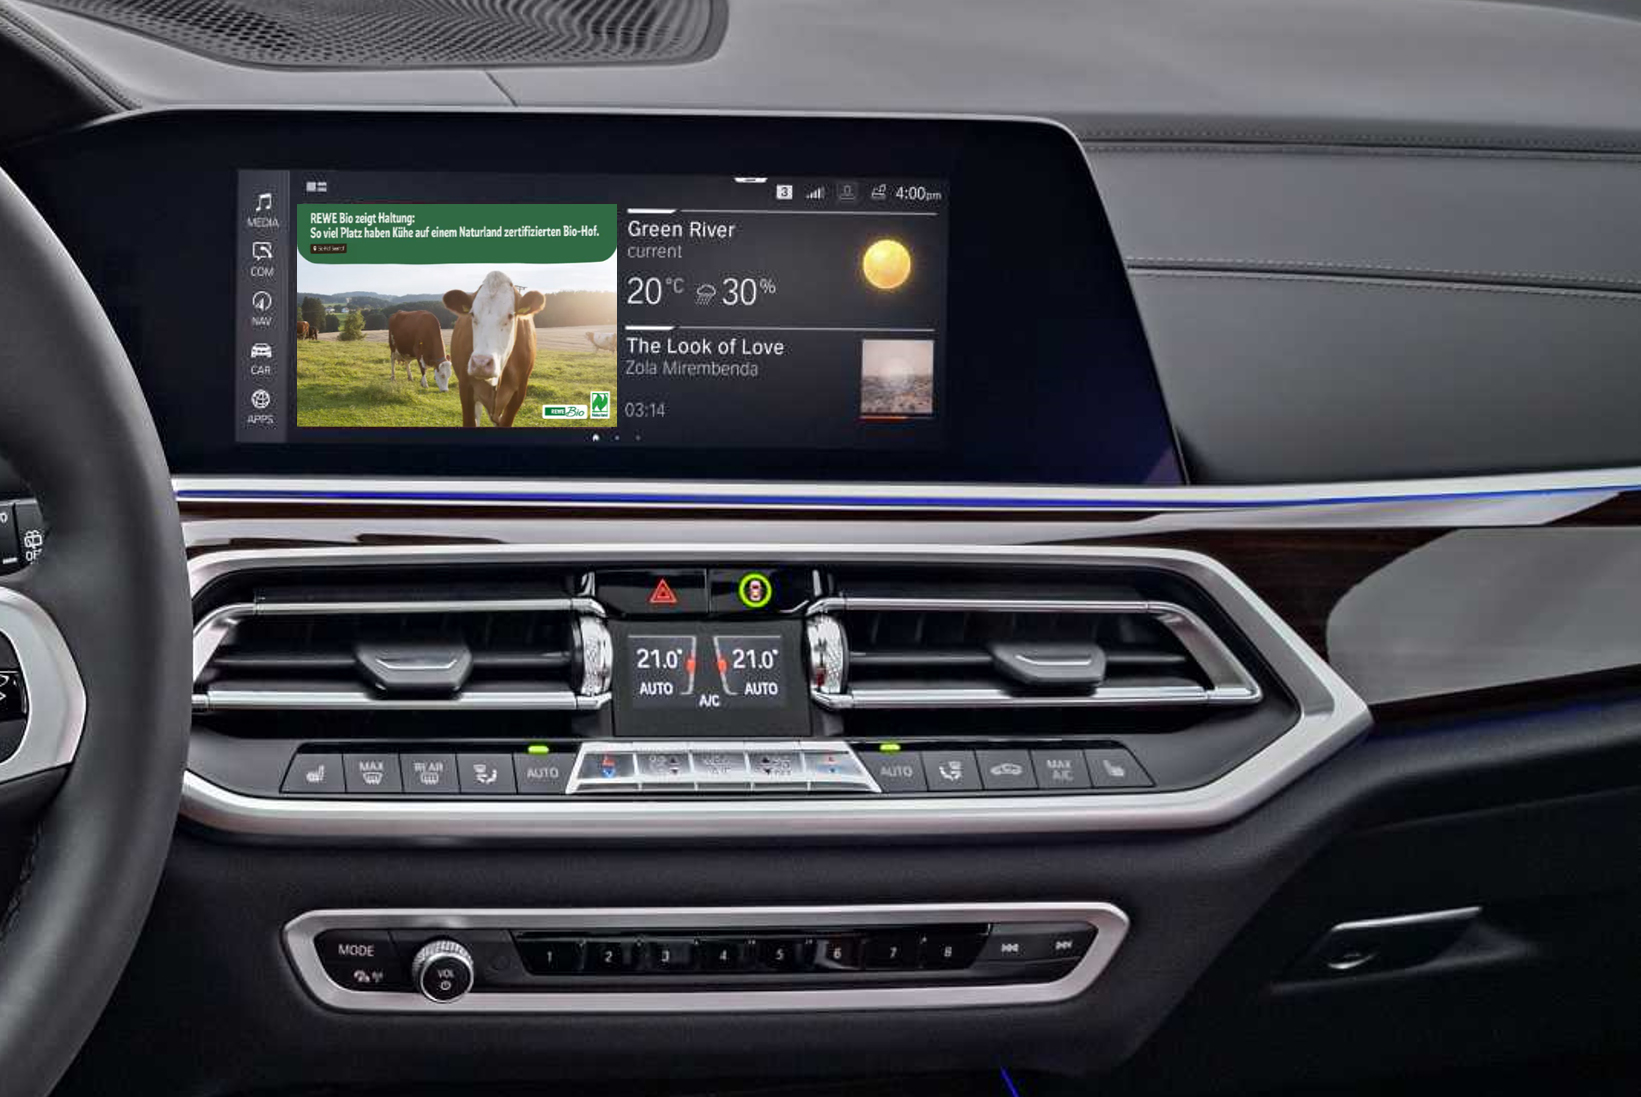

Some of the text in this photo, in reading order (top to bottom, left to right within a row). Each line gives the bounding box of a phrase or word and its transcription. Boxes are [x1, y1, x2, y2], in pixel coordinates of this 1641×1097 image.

[895, 186, 942, 201] 4:00pm
[247, 218, 279, 228] MEDIA
[310, 212, 415, 226] REWE Bio zeigt Haltung:
[310, 224, 600, 239] So viel Platz haben Kühe auf einem Naturland zertifizierten Bio-Hof.
[627, 220, 735, 238] Green River
[627, 245, 683, 259] current
[250, 267, 274, 277] COM
[252, 316, 272, 327] NAV
[625, 337, 785, 355] The Look of Love
[250, 365, 271, 375] CAR
[625, 360, 759, 376] Zola Mirembenda
[566, 406, 585, 417] Bio
[624, 403, 666, 417] 03:14
[247, 415, 274, 425] APPS
[639, 681, 779, 695] AUTO AUTO
[699, 694, 721, 707] A/C
[360, 761, 385, 772] MAX
[1047, 759, 1071, 769] MAX
[526, 767, 559, 779] AUTO
[880, 765, 913, 778] AUTO
[1052, 771, 1073, 781] A/C
[338, 942, 375, 957] MODE
